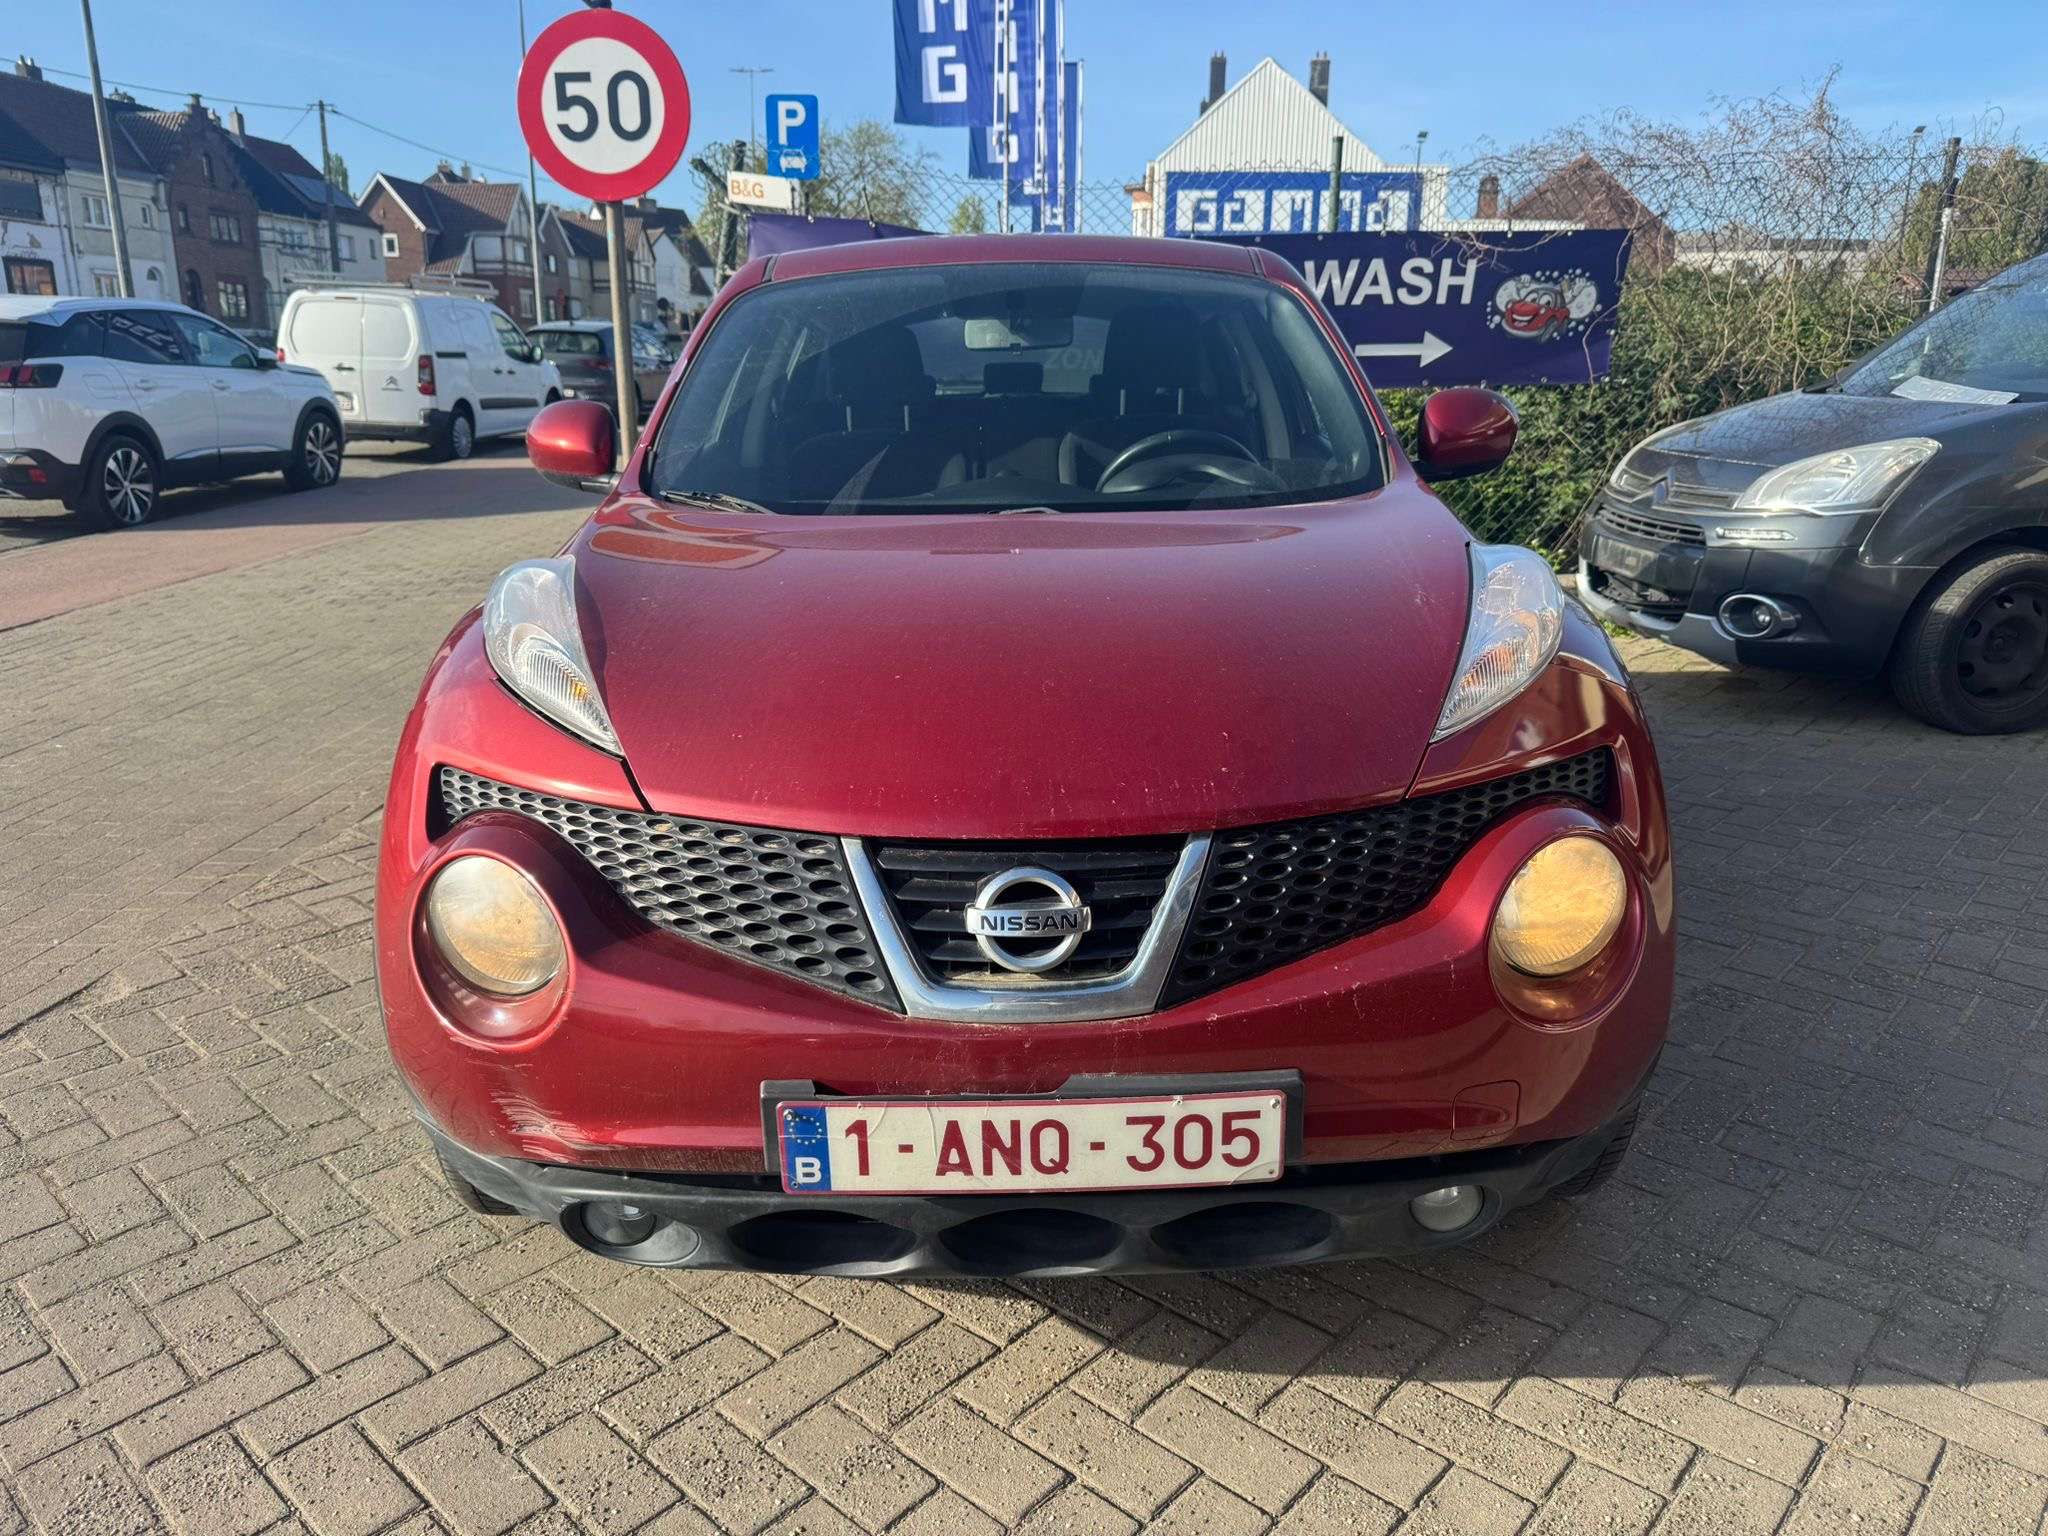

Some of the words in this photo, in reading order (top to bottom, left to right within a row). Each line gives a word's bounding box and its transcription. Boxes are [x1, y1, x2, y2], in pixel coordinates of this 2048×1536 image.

[554, 70, 652, 142] 50
[777, 101, 806, 145] P
[731, 179, 764, 198] B&G
[1304, 257, 1477, 306] WASH
[980, 913, 1078, 932] NISSAN
[845, 1109, 1261, 1178] 1-ANQ-305
[795, 1157, 822, 1184] B
